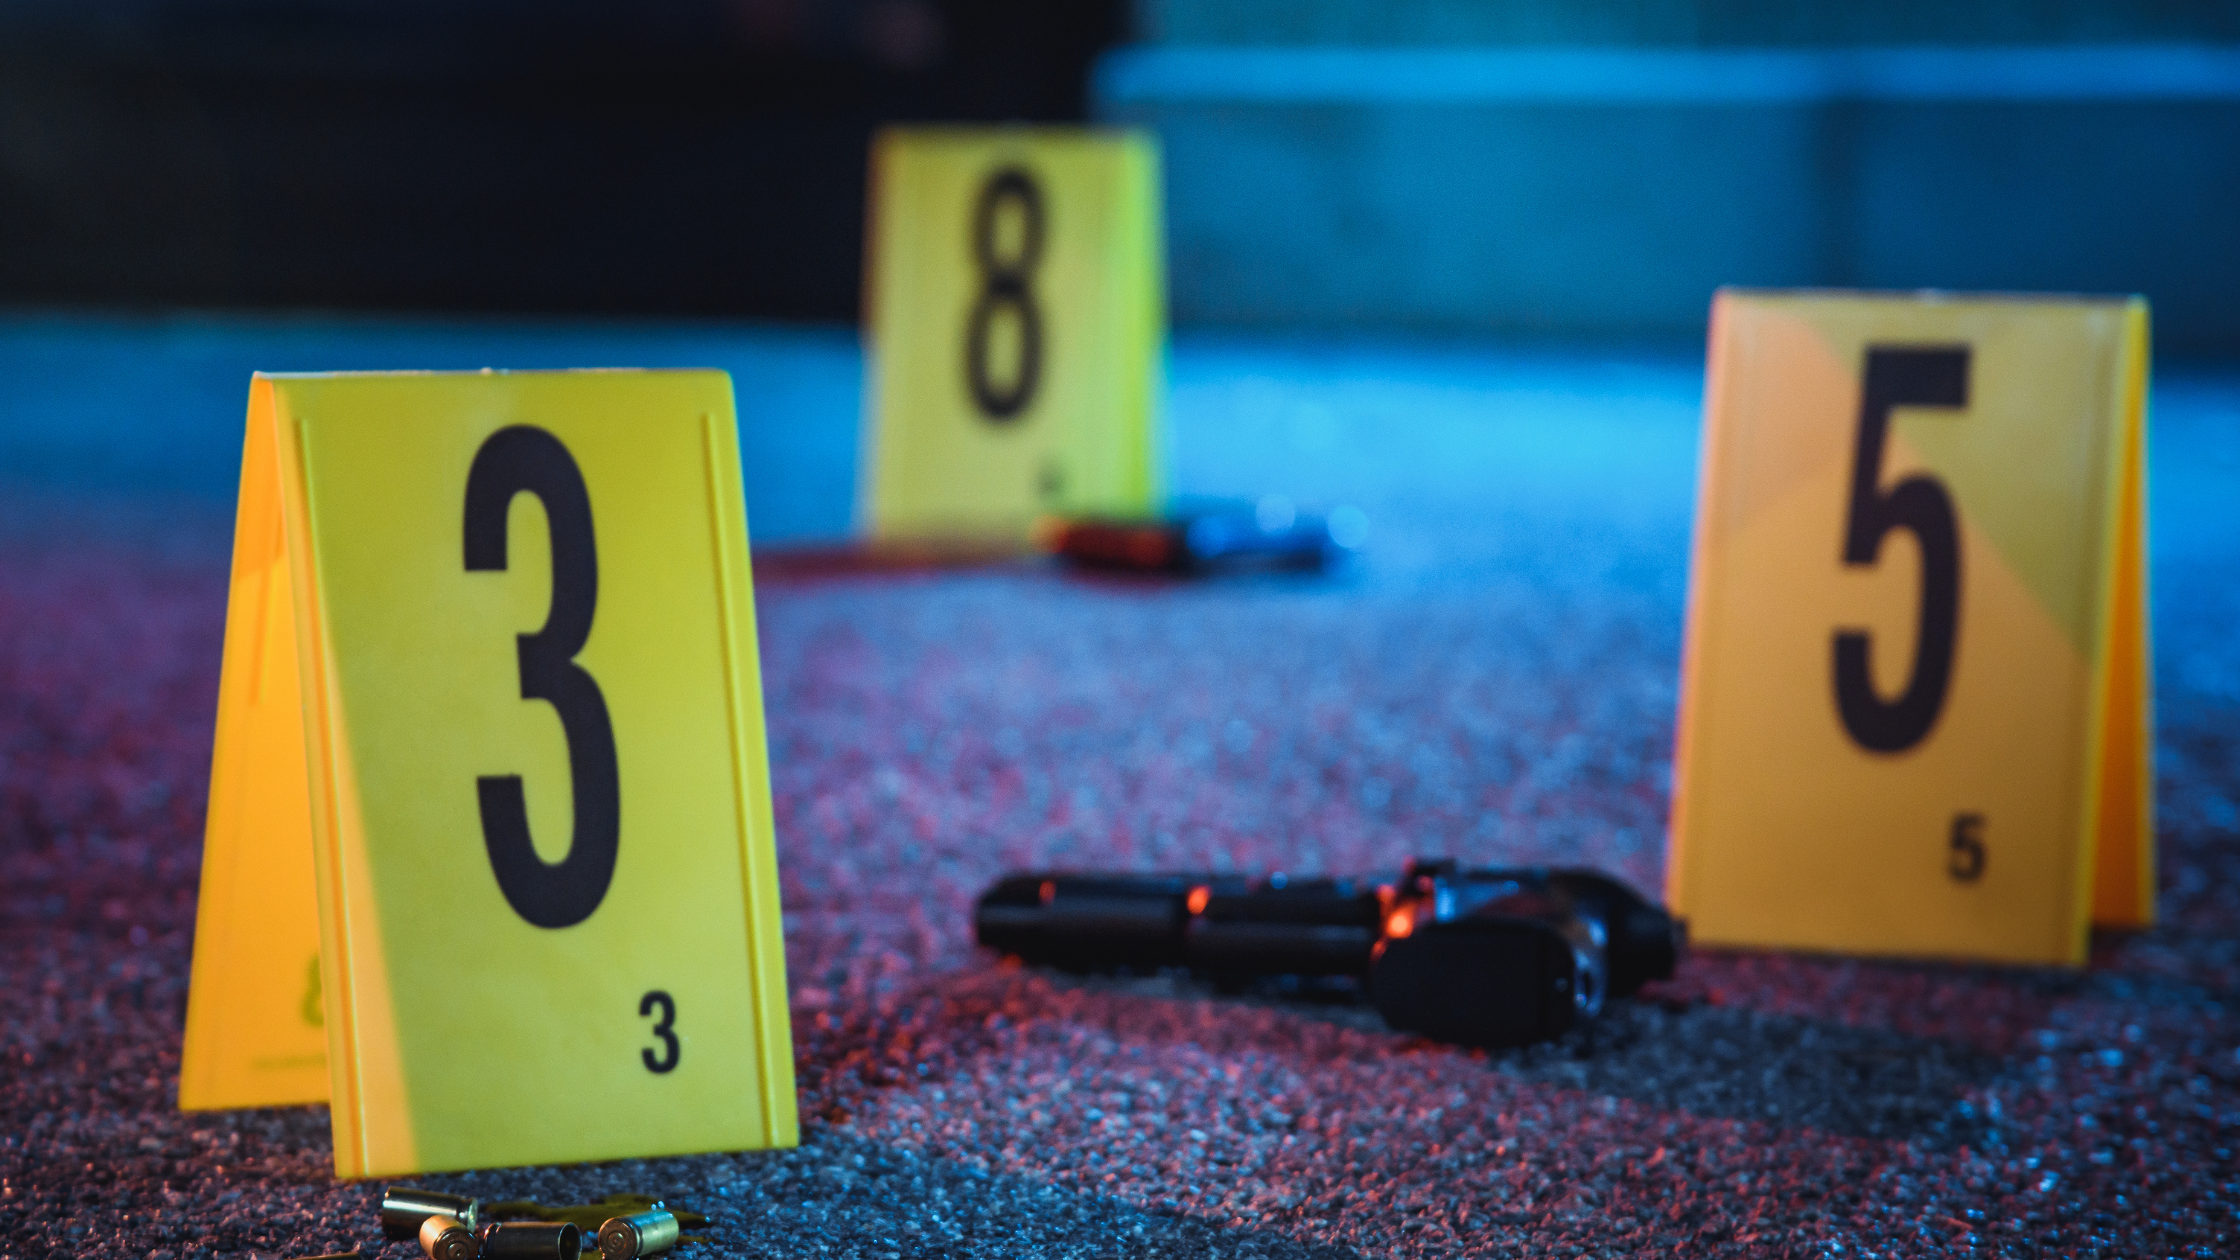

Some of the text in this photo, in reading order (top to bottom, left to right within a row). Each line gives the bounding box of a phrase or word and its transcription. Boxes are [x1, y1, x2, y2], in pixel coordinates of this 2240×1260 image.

[963, 161, 1047, 424] 8
[462, 424, 621, 930] 3
[1832, 343, 1973, 756] 5
[1947, 814, 1987, 884] 5
[638, 990, 681, 1075] 3
